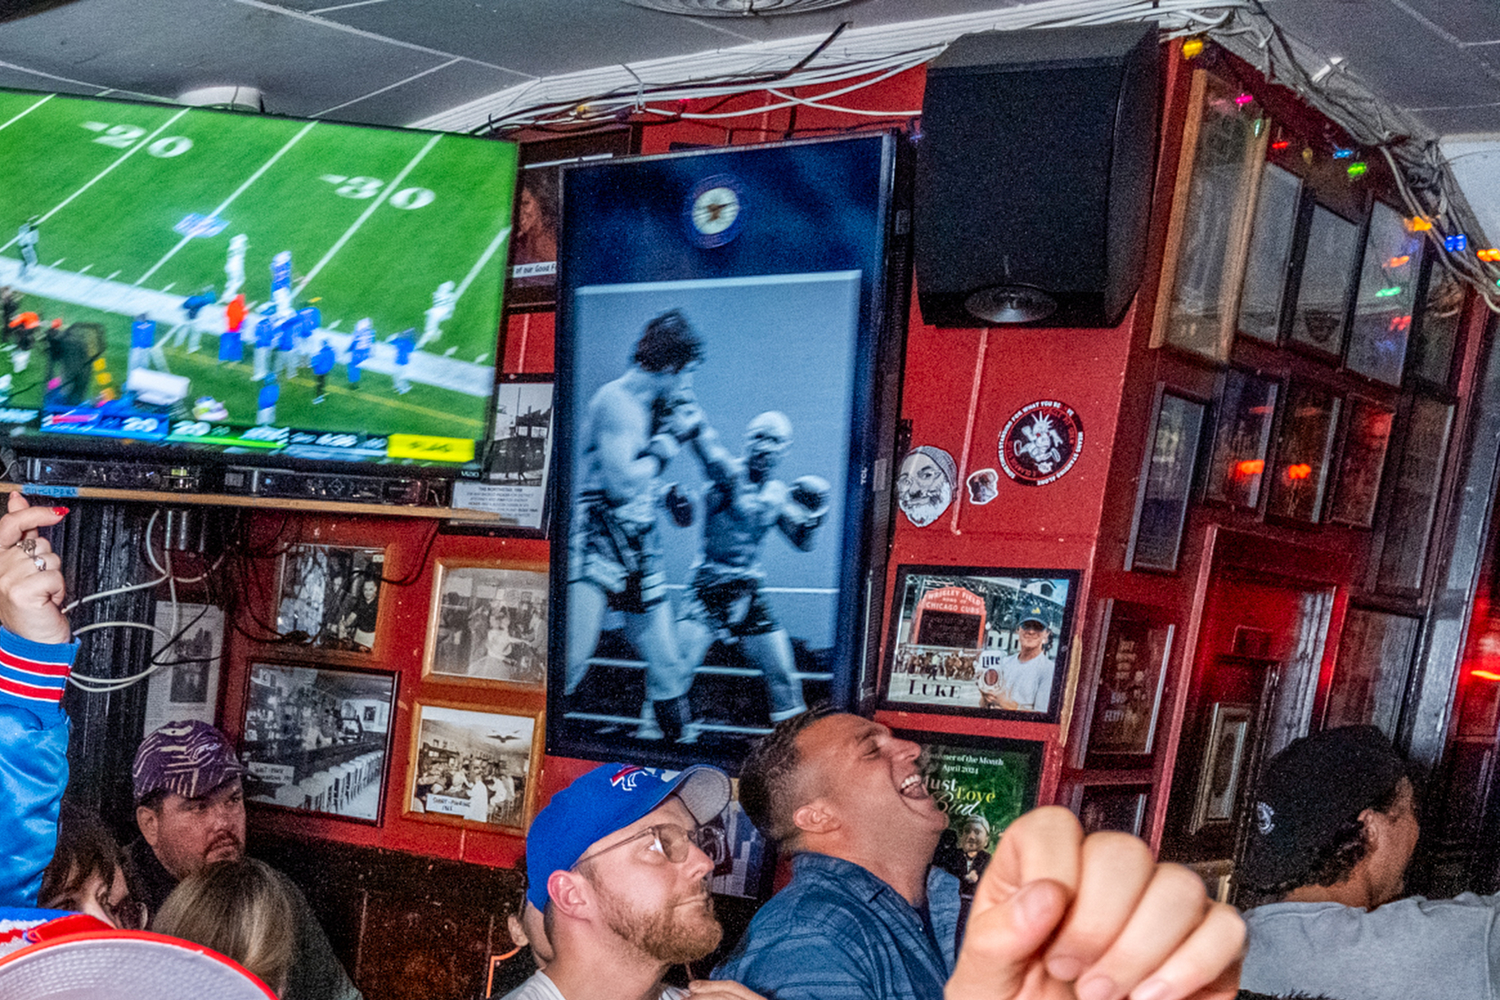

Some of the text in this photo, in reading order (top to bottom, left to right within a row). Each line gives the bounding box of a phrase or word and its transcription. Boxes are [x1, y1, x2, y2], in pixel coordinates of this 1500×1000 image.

[927, 589, 981, 606] WRIGLEY FIELD
[925, 602, 980, 614] CHICAGO CUBS
[981, 655, 1001, 669] Lite
[908, 679, 962, 699] LUKE
[941, 763, 960, 773] April
[979, 756, 1004, 766] Month
[957, 785, 996, 804] Love
